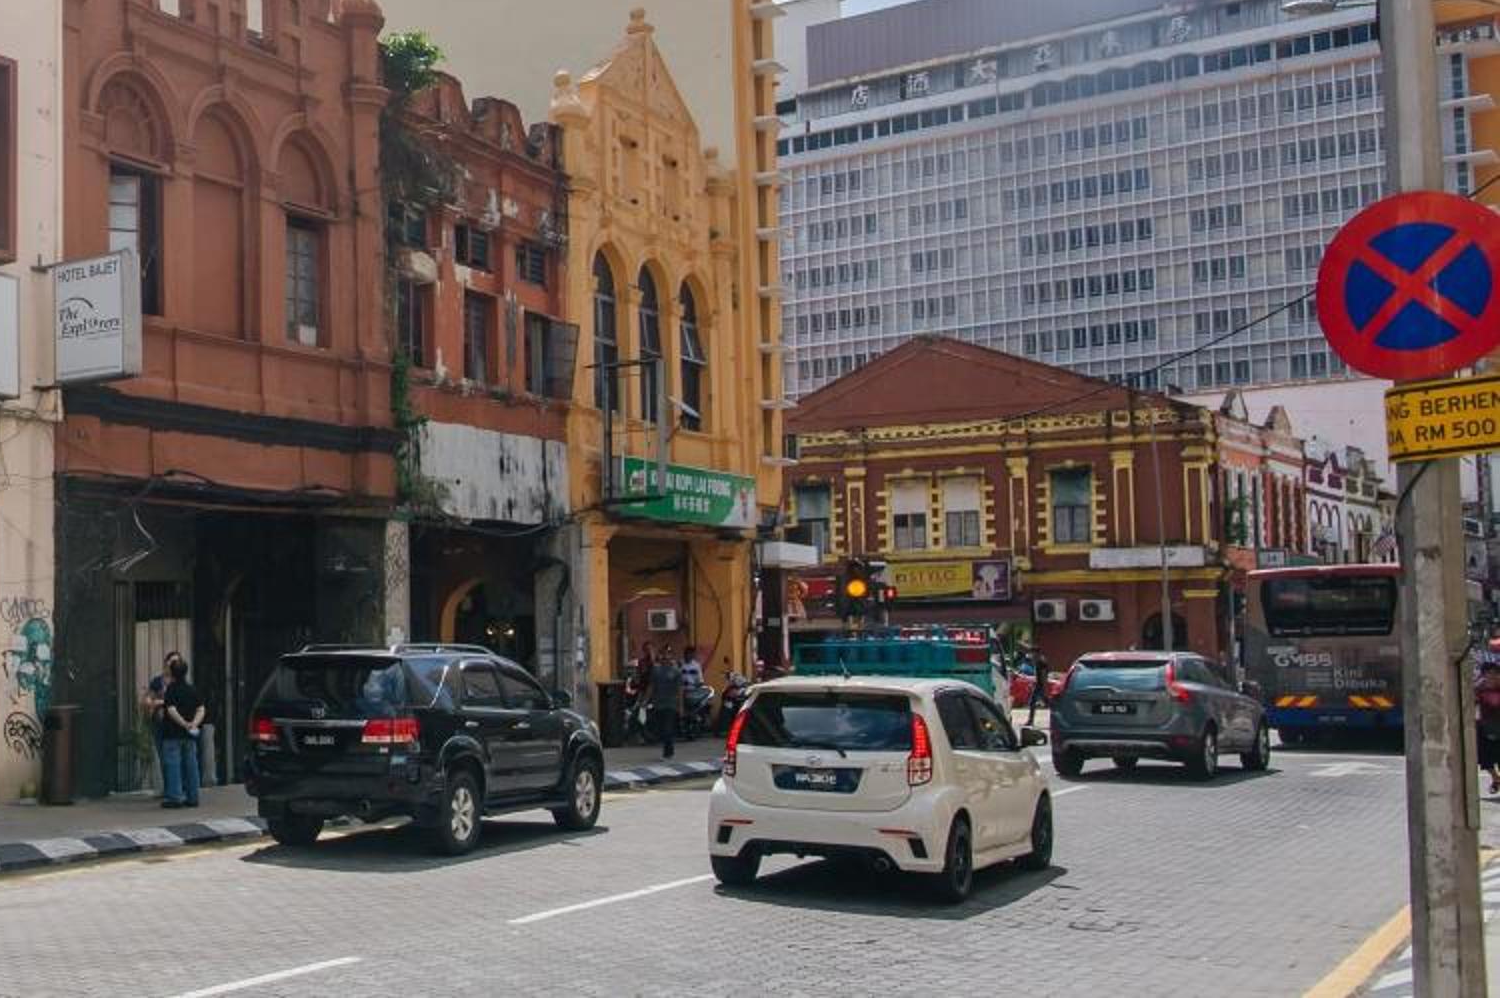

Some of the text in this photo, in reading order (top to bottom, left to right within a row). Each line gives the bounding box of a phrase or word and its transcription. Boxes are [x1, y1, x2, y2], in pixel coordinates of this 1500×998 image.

[58, 259, 117, 283] HOTEL BAJET
[60, 307, 79, 323] The
[62, 317, 119, 337] Explorers
[1416, 424, 1445, 443] RM
[1452, 418, 1496, 439] 500
[649, 469, 674, 490] KAI
